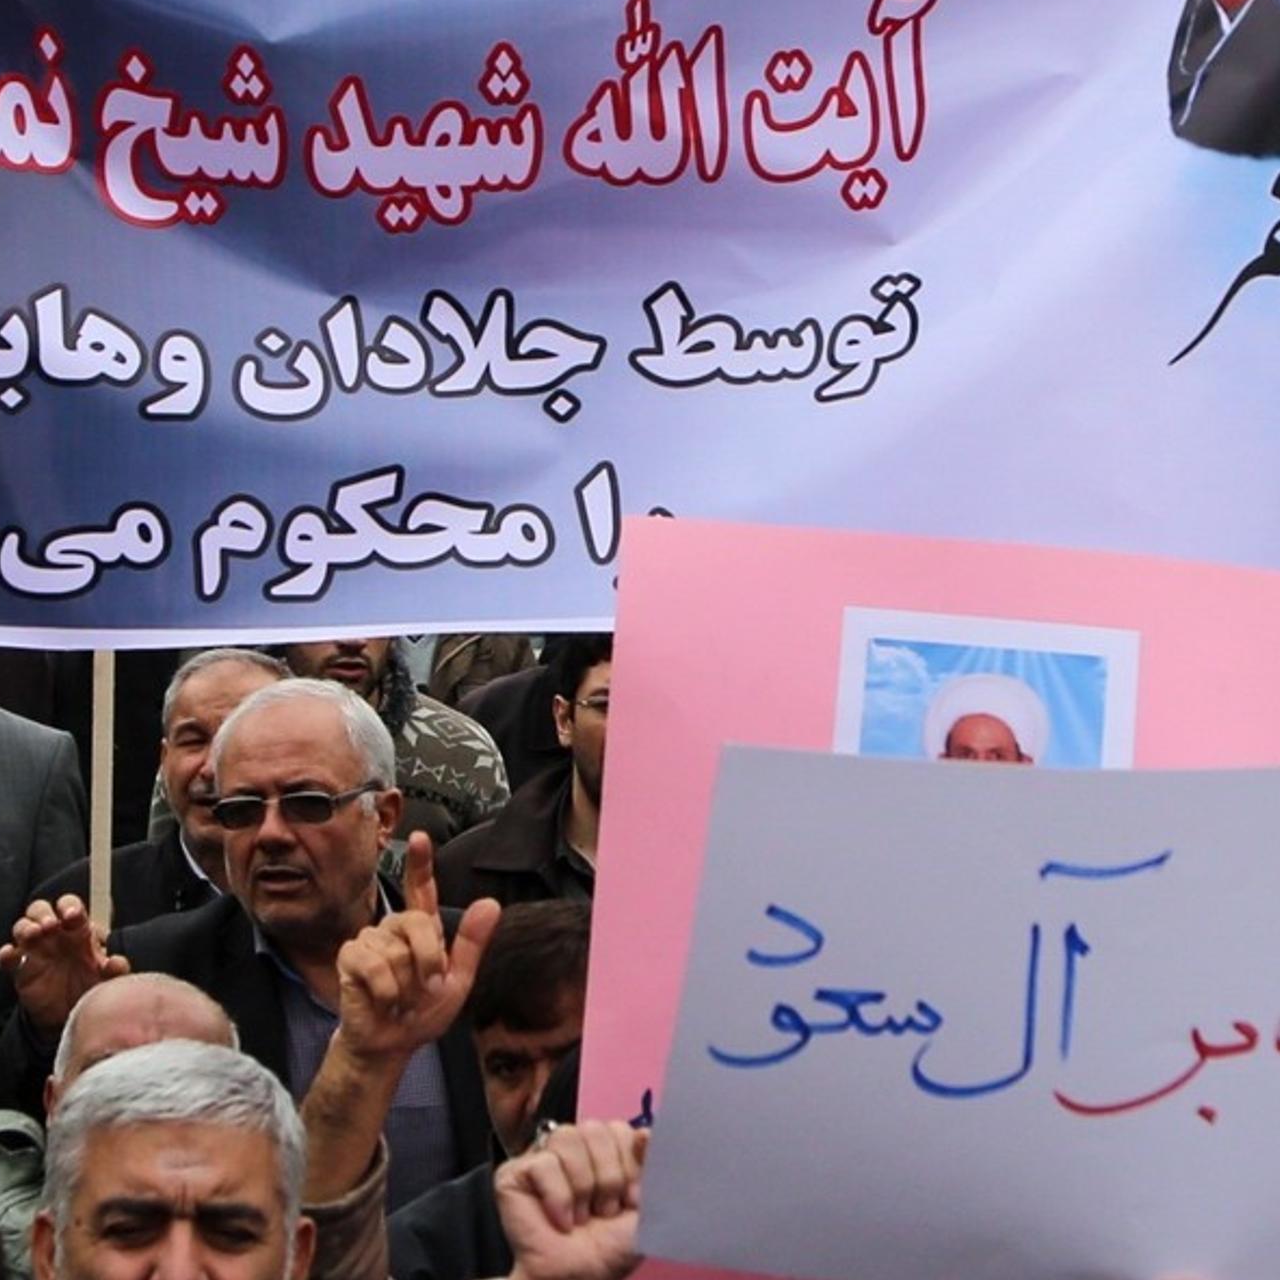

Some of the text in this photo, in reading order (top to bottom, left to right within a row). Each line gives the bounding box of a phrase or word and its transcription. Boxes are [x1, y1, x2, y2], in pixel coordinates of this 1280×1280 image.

[96, 41, 286, 229] شیخ
[305, 41, 544, 234] شهید
[233, 287, 608, 423] جلادان
[629, 272, 923, 404] توسط
[194, 463, 556, 604] محکوم
[706, 904, 945, 1071] سعود
[910, 849, 1173, 1099] آل
[1051, 1017, 1261, 1127] بر
